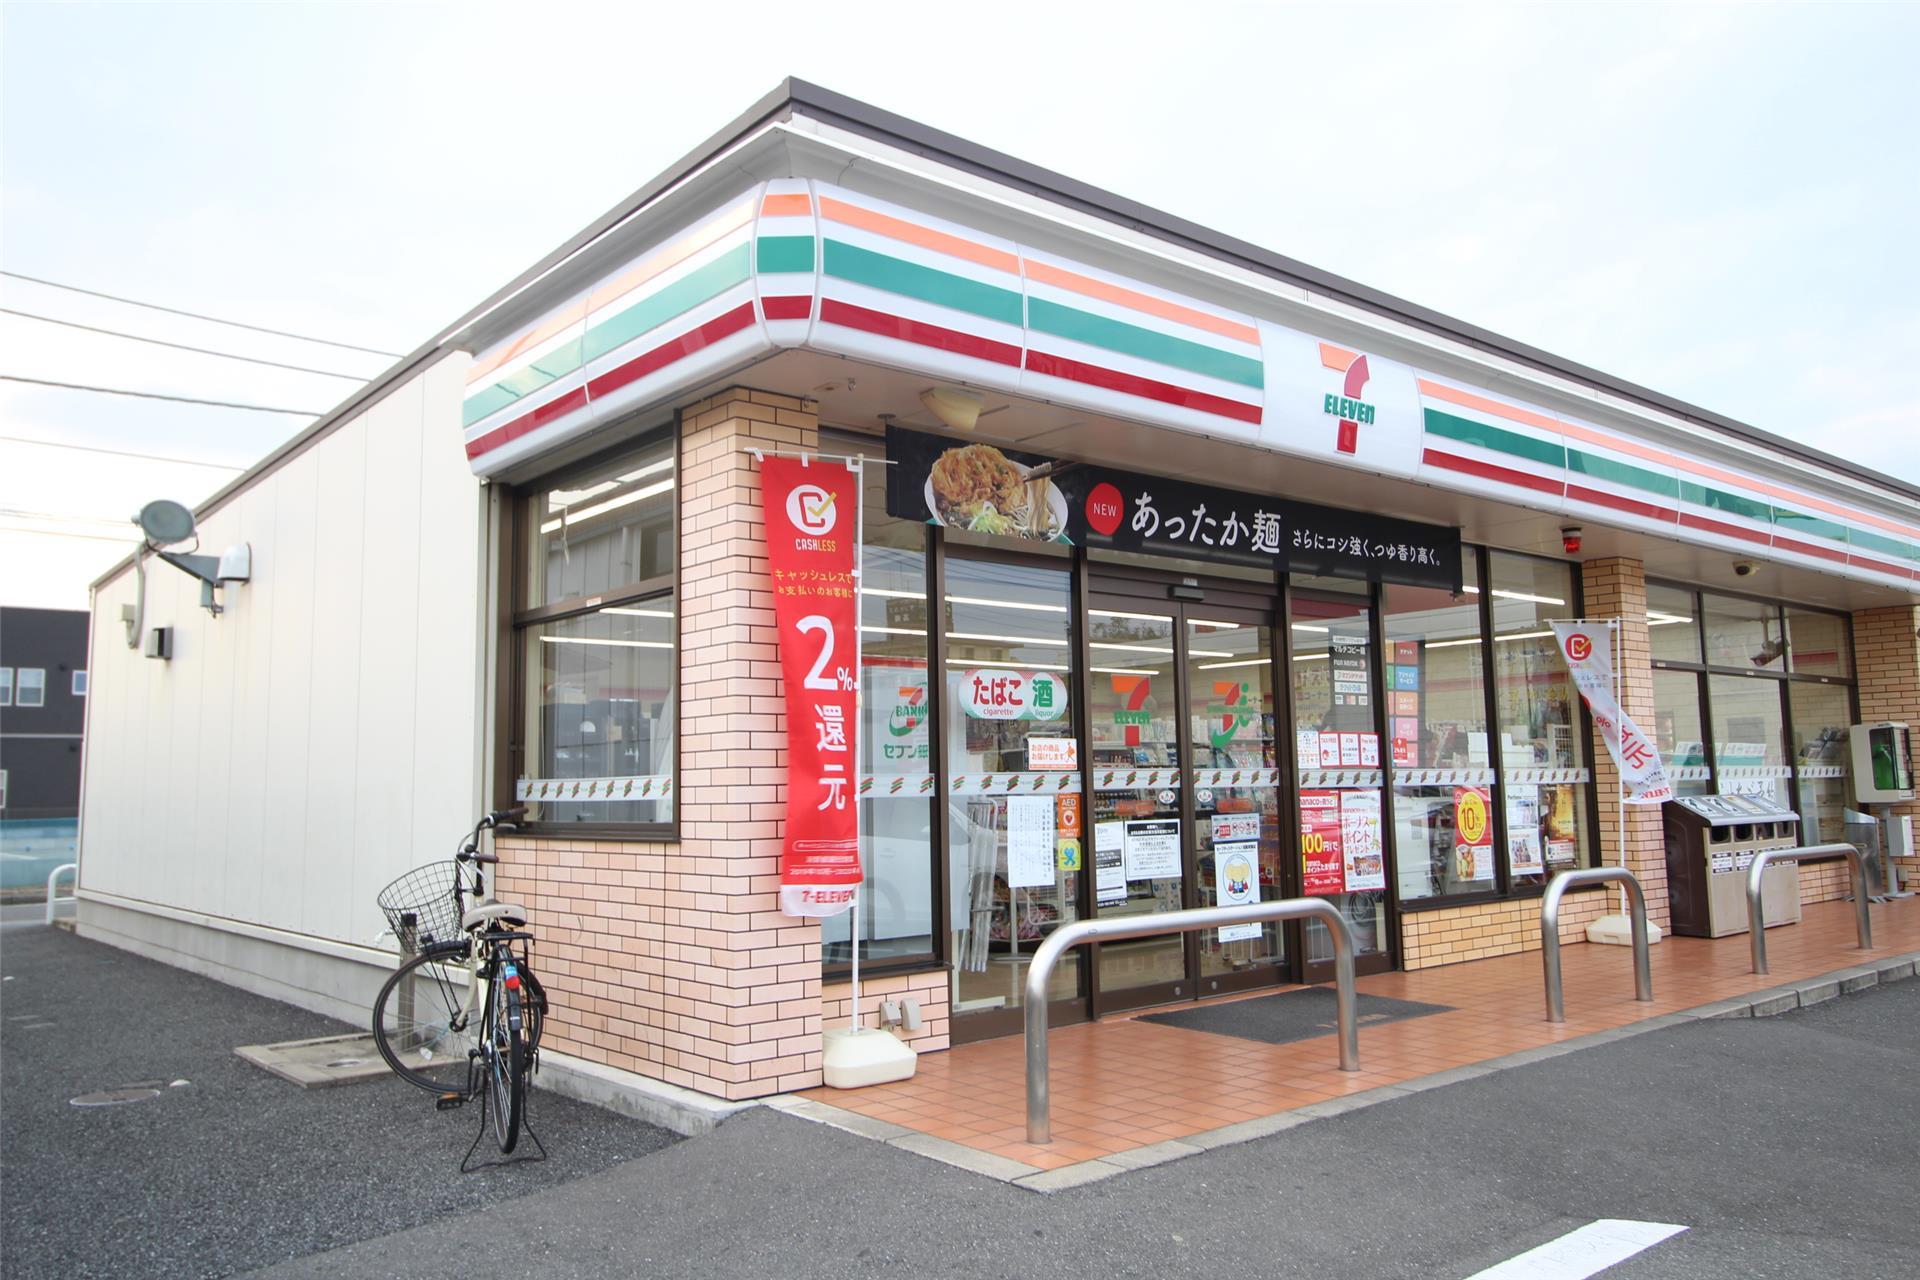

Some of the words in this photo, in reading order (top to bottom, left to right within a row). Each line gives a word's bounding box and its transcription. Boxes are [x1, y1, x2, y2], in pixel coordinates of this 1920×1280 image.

[1093, 502, 1117, 517] NEW
[1132, 490, 1281, 555] あったか麺
[795, 538, 836, 552] CASHLESS
[1292, 528, 1441, 567] さらにコシ強く、つゆ香り高く。
[973, 676, 1023, 706] たばこ
[1032, 679, 1053, 707] 酒
[983, 707, 1014, 716] cigarette
[1034, 708, 1053, 718] liquor
[814, 703, 847, 811] 還元
[1062, 798, 1076, 806] AED
